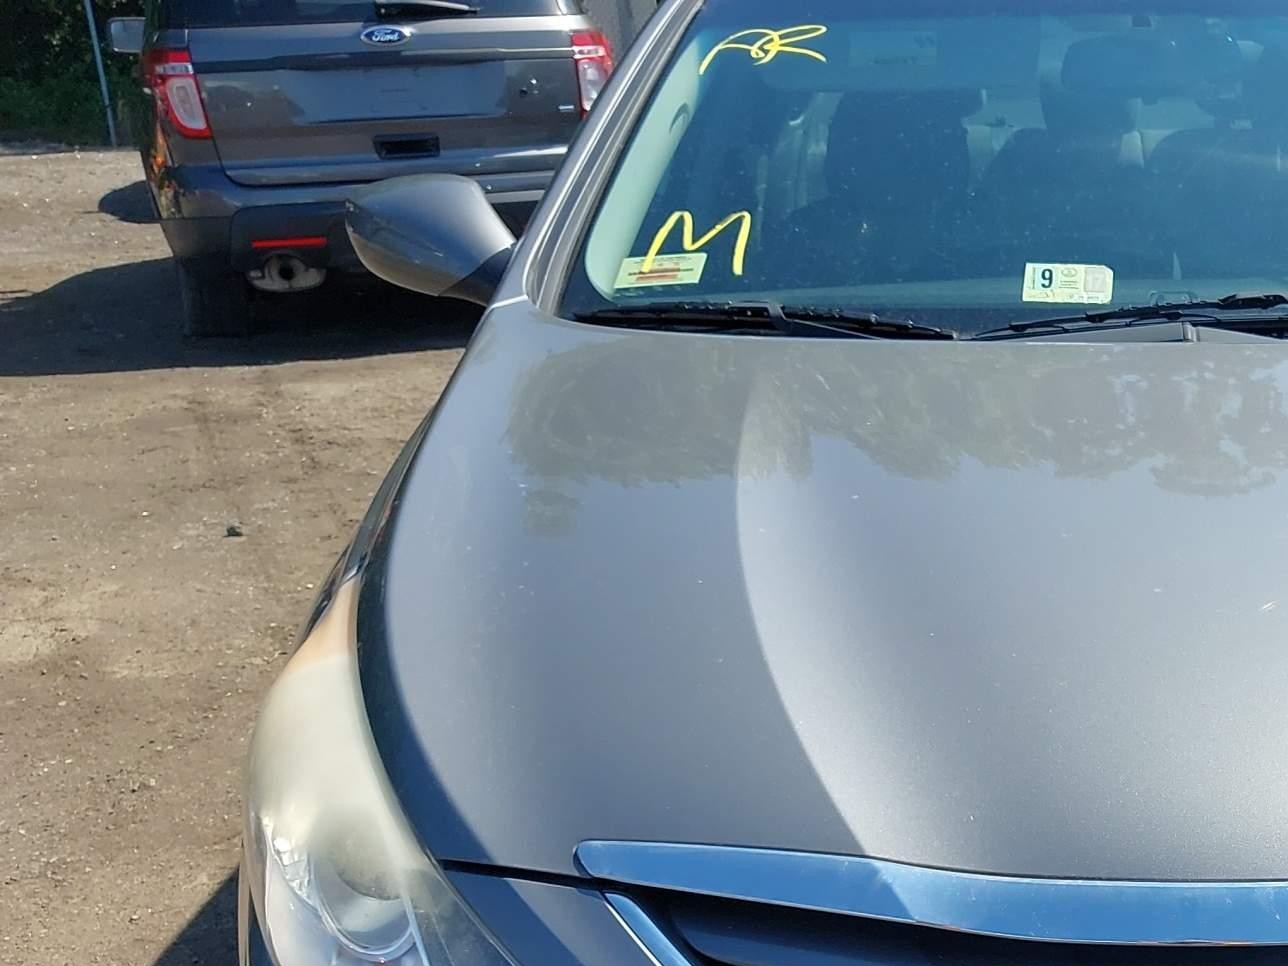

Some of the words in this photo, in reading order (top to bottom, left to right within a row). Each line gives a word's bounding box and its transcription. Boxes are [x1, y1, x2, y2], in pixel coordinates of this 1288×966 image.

[371, 29, 400, 42] Ford
[642, 210, 752, 276] M
[1040, 268, 1054, 289] 9
